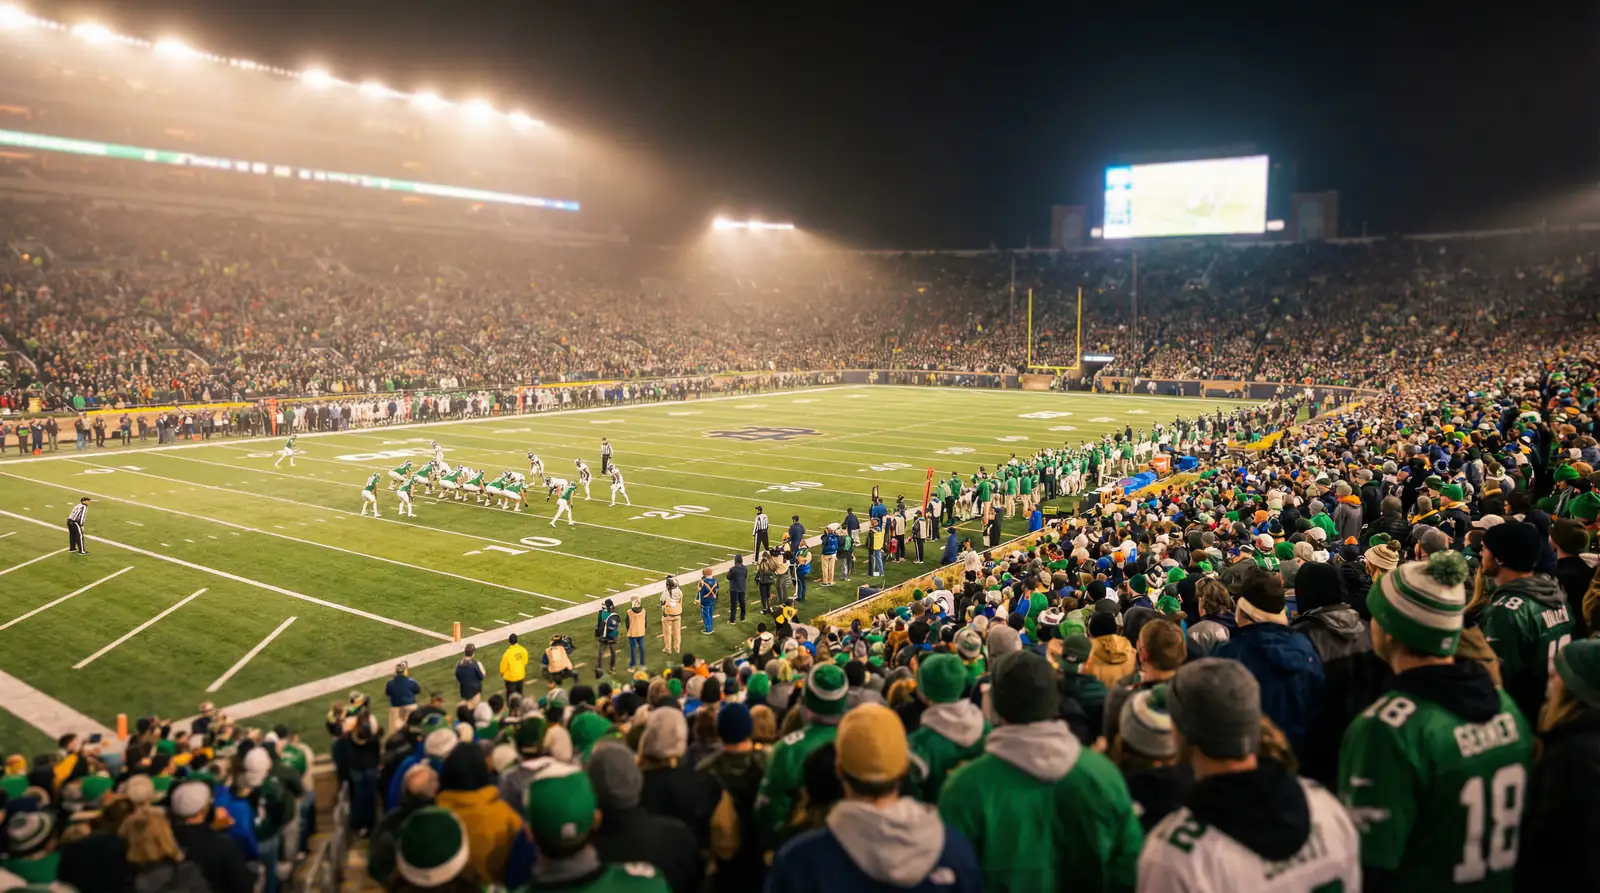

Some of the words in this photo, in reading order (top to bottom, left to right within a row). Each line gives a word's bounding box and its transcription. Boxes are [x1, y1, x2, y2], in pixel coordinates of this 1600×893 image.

[642, 505, 710, 520] 20
[483, 536, 562, 556] 10
[1453, 762, 1528, 885] 18
